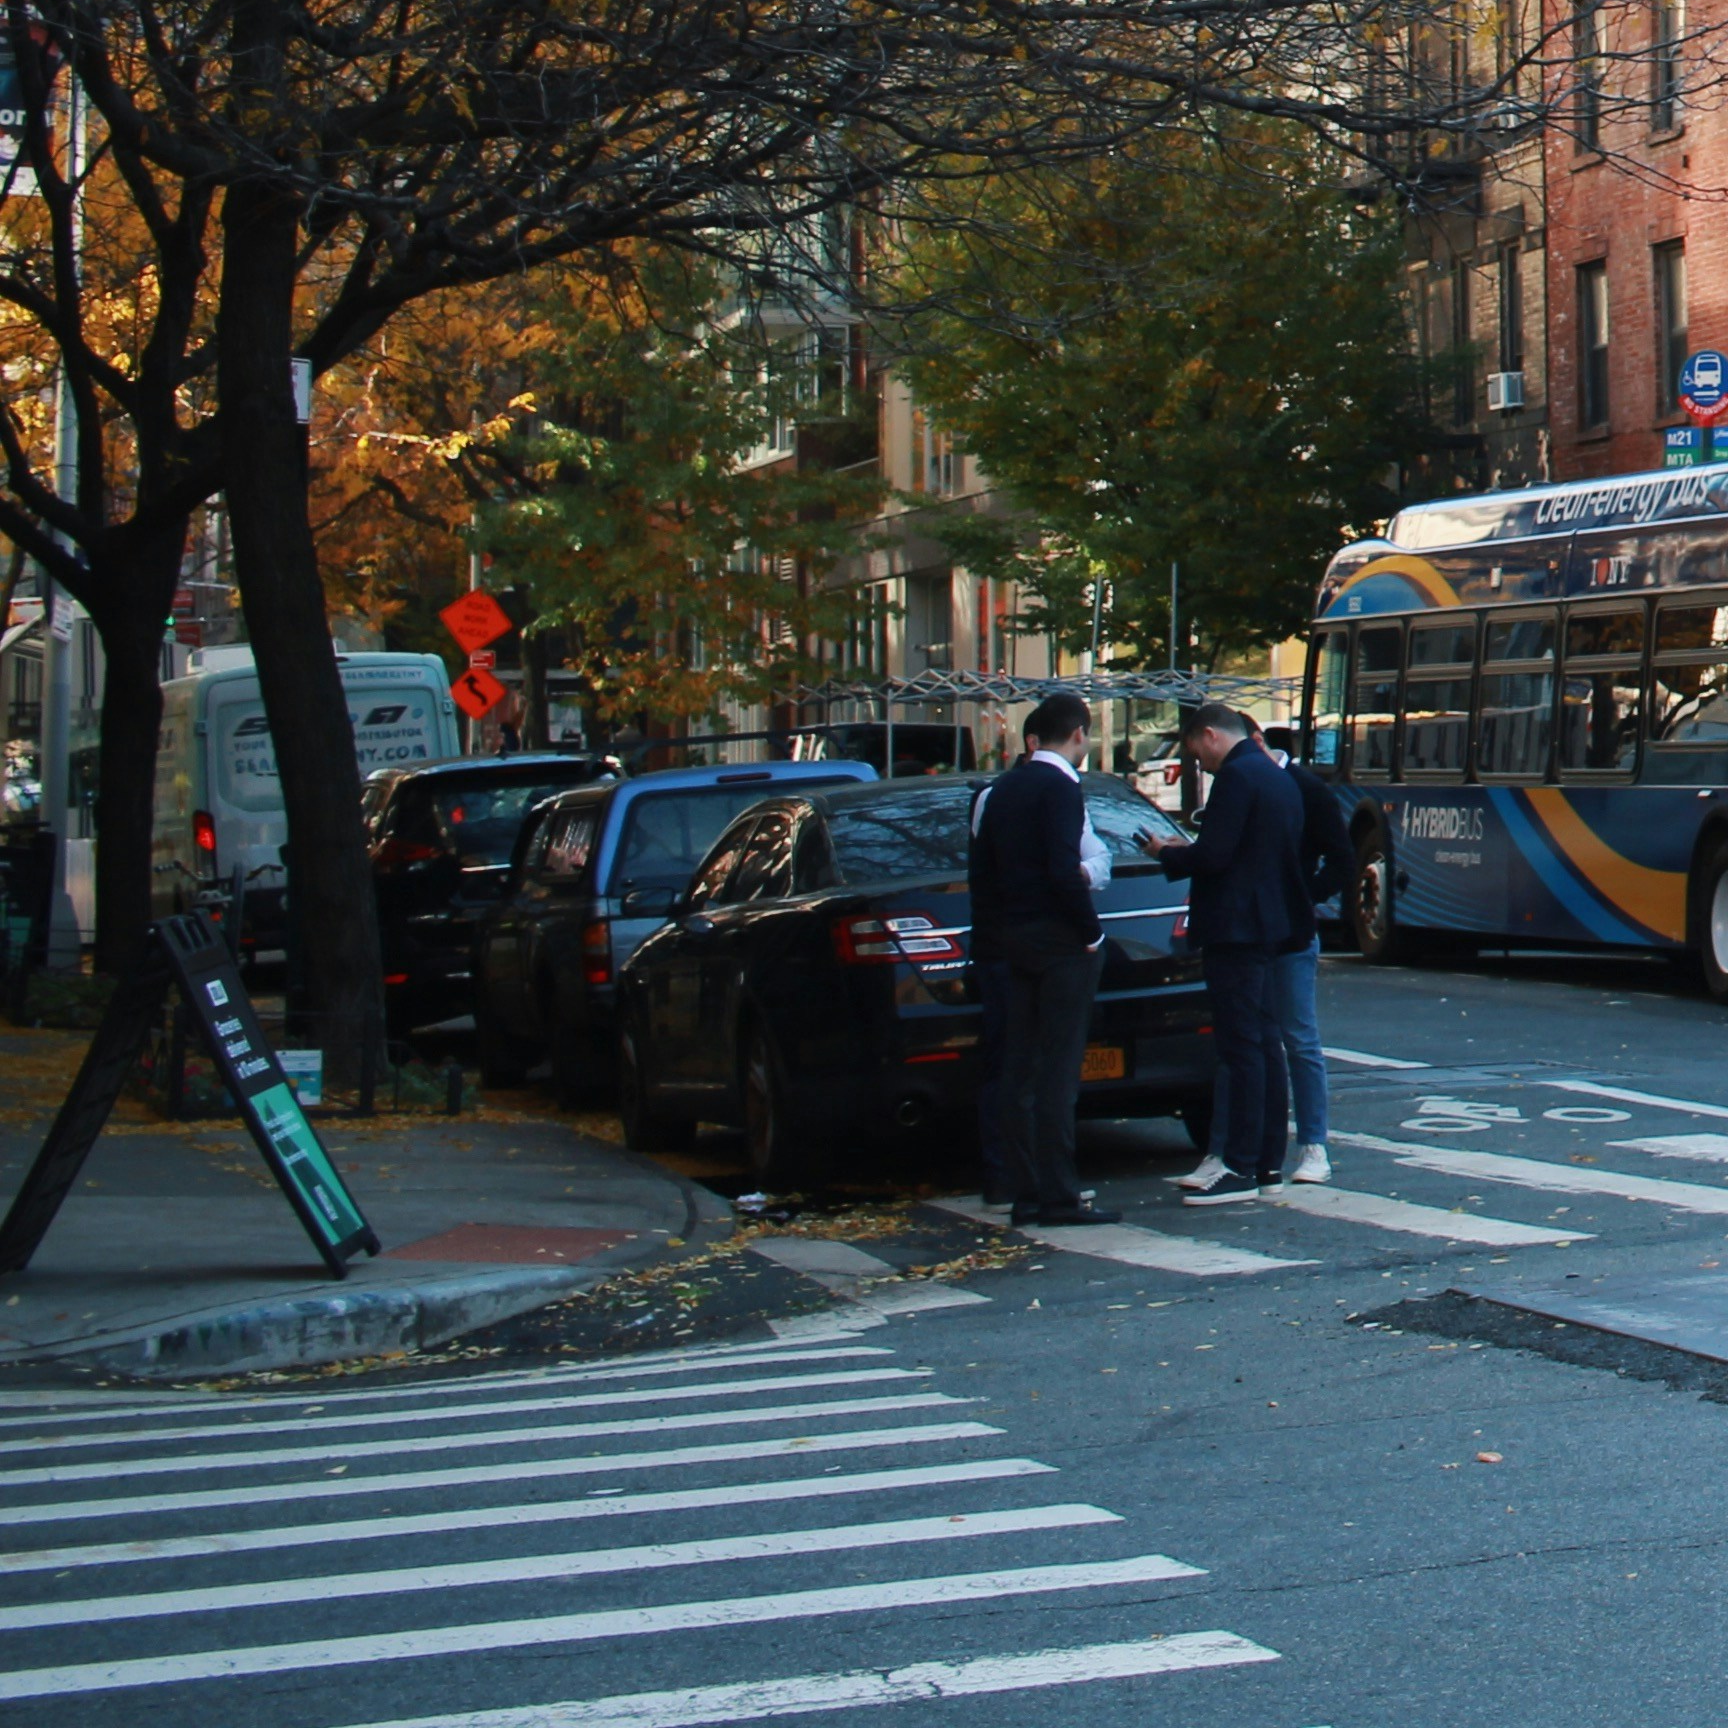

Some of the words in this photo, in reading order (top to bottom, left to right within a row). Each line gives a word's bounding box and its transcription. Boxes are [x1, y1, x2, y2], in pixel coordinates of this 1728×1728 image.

[1667, 430, 1692, 446] M21
[1667, 453, 1693, 466] MTA
[1536, 476, 1664, 523] clean-energy
[1668, 472, 1709, 505] bus
[1411, 807, 1484, 840] HYBRIDBUS
